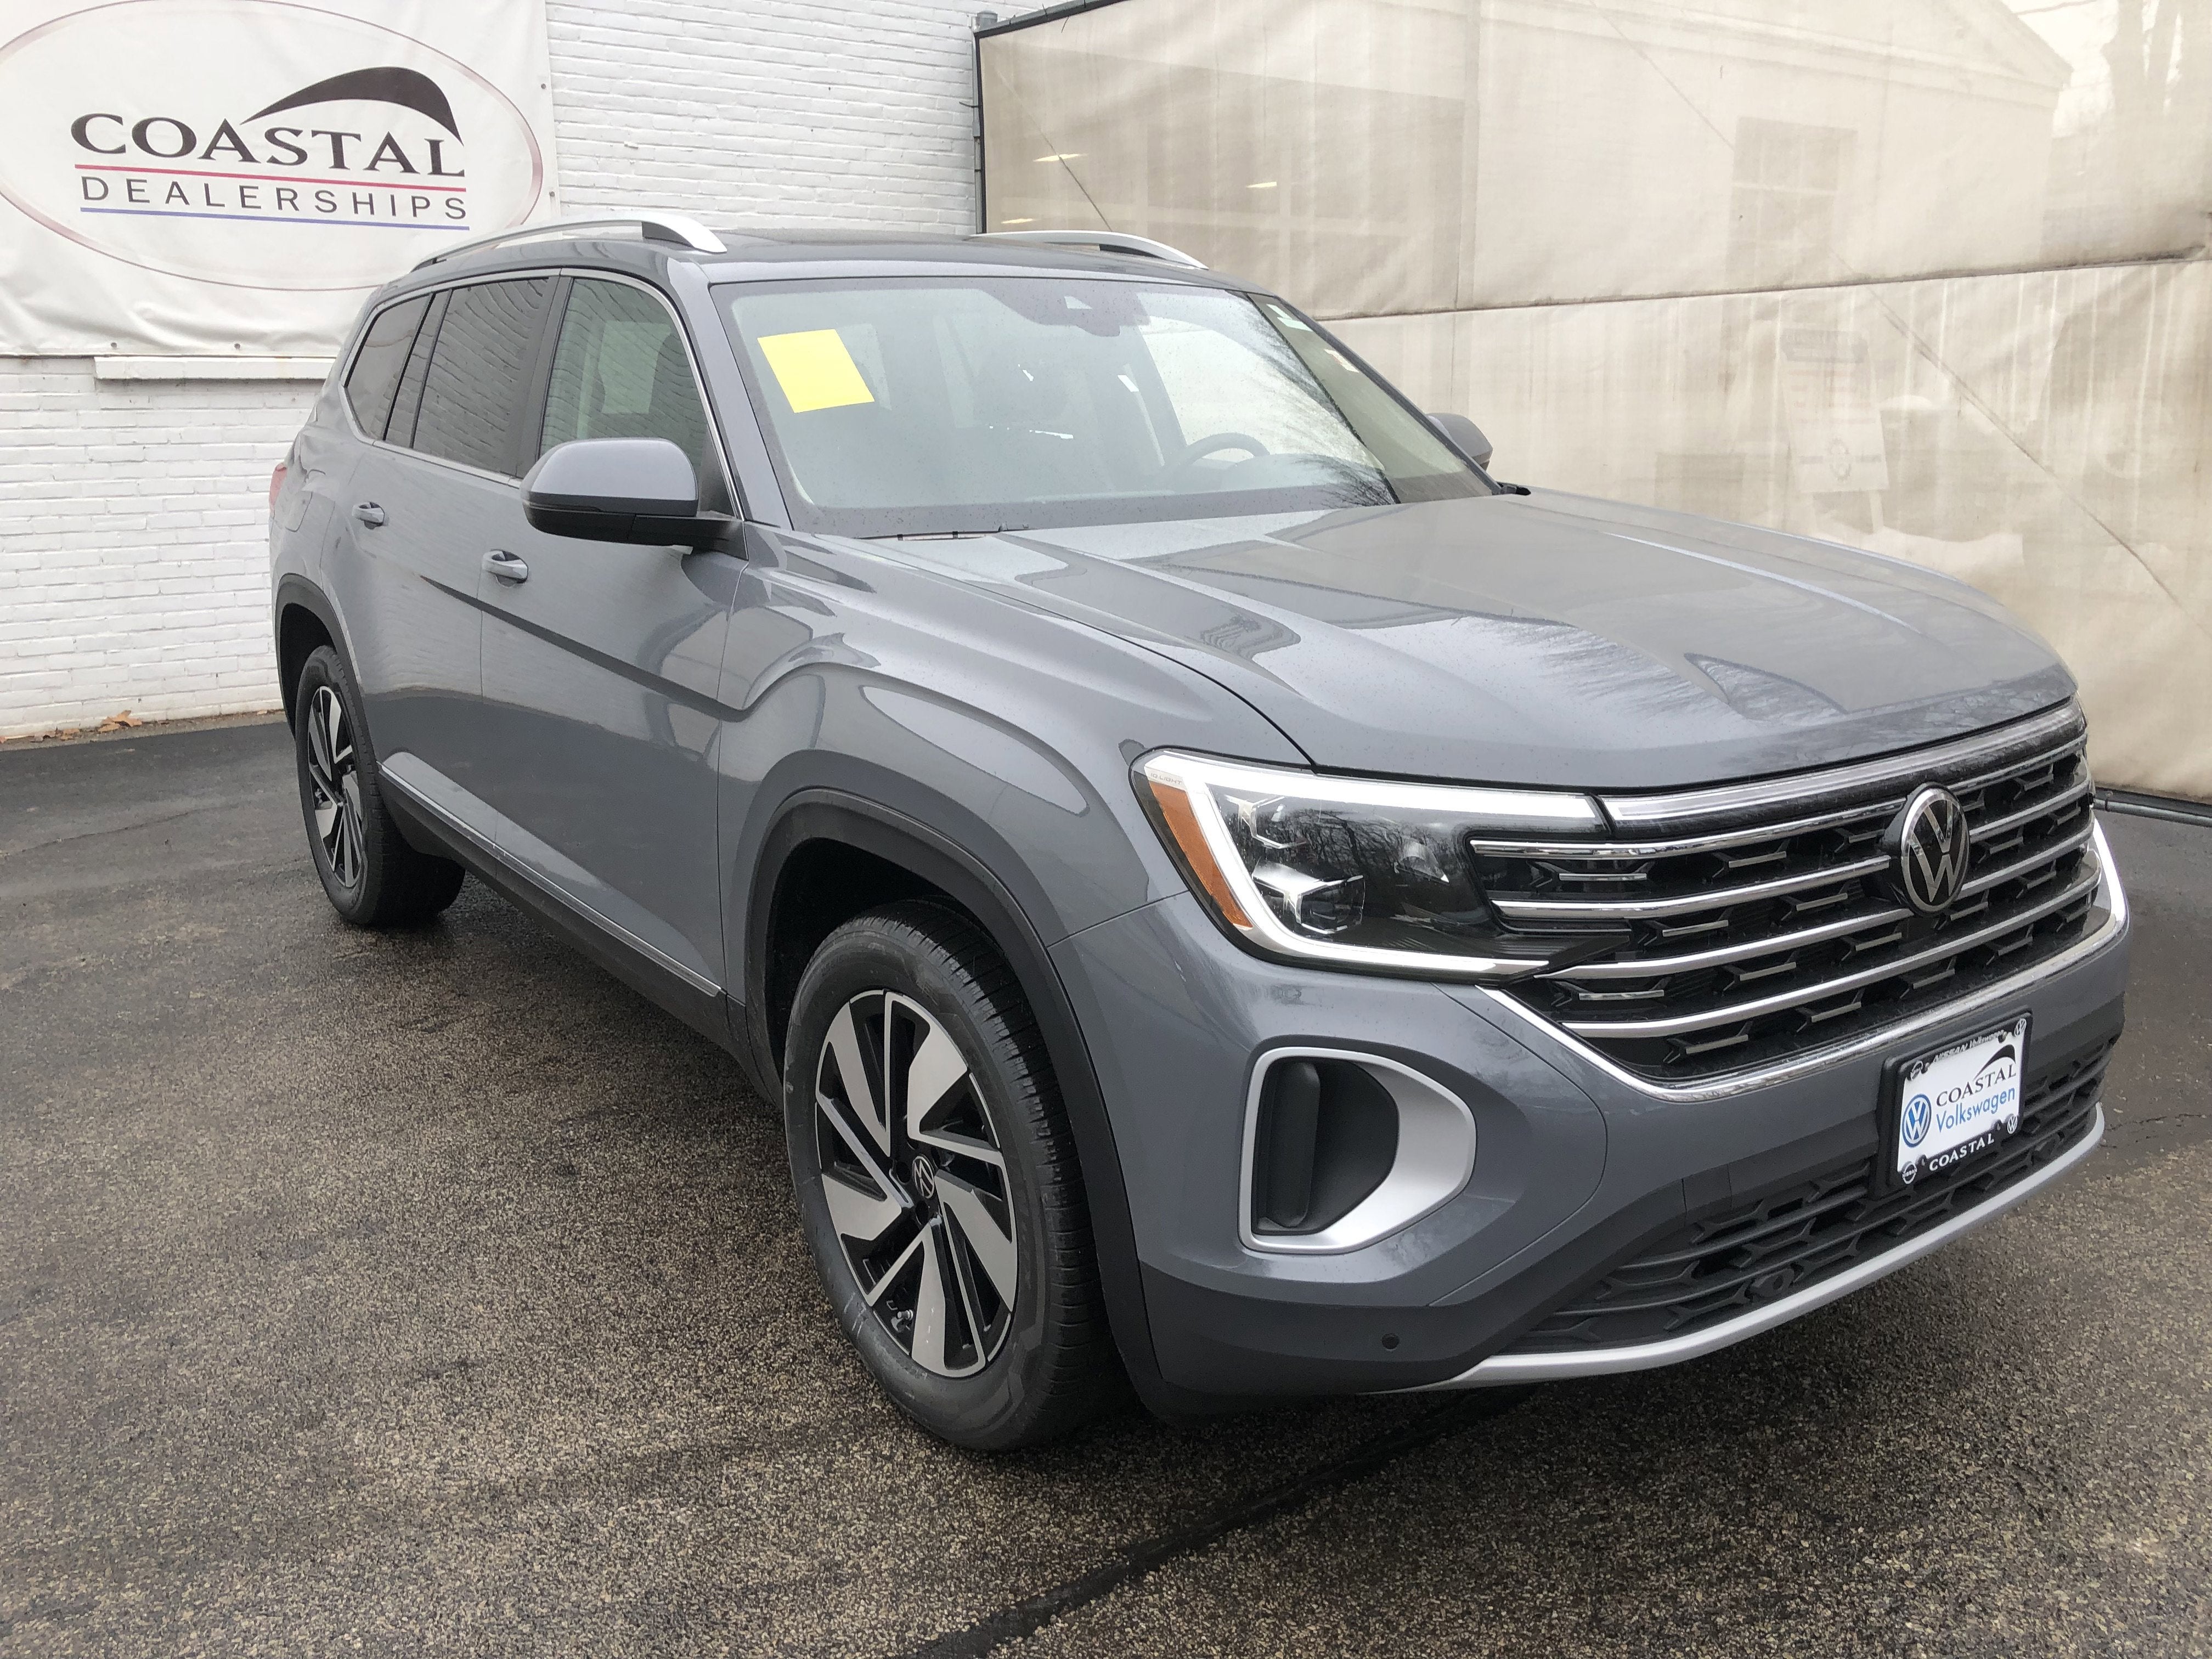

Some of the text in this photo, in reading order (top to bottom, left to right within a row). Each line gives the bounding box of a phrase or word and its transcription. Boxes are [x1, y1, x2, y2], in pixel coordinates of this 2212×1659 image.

[71, 112, 465, 177] COASTAL
[81, 176, 466, 220] DEALERSHIPS
[1936, 1063, 2017, 1107] COASTAL
[1936, 1087, 2016, 1133] Volkswagen
[1929, 1134, 1994, 1171] COASTAL
